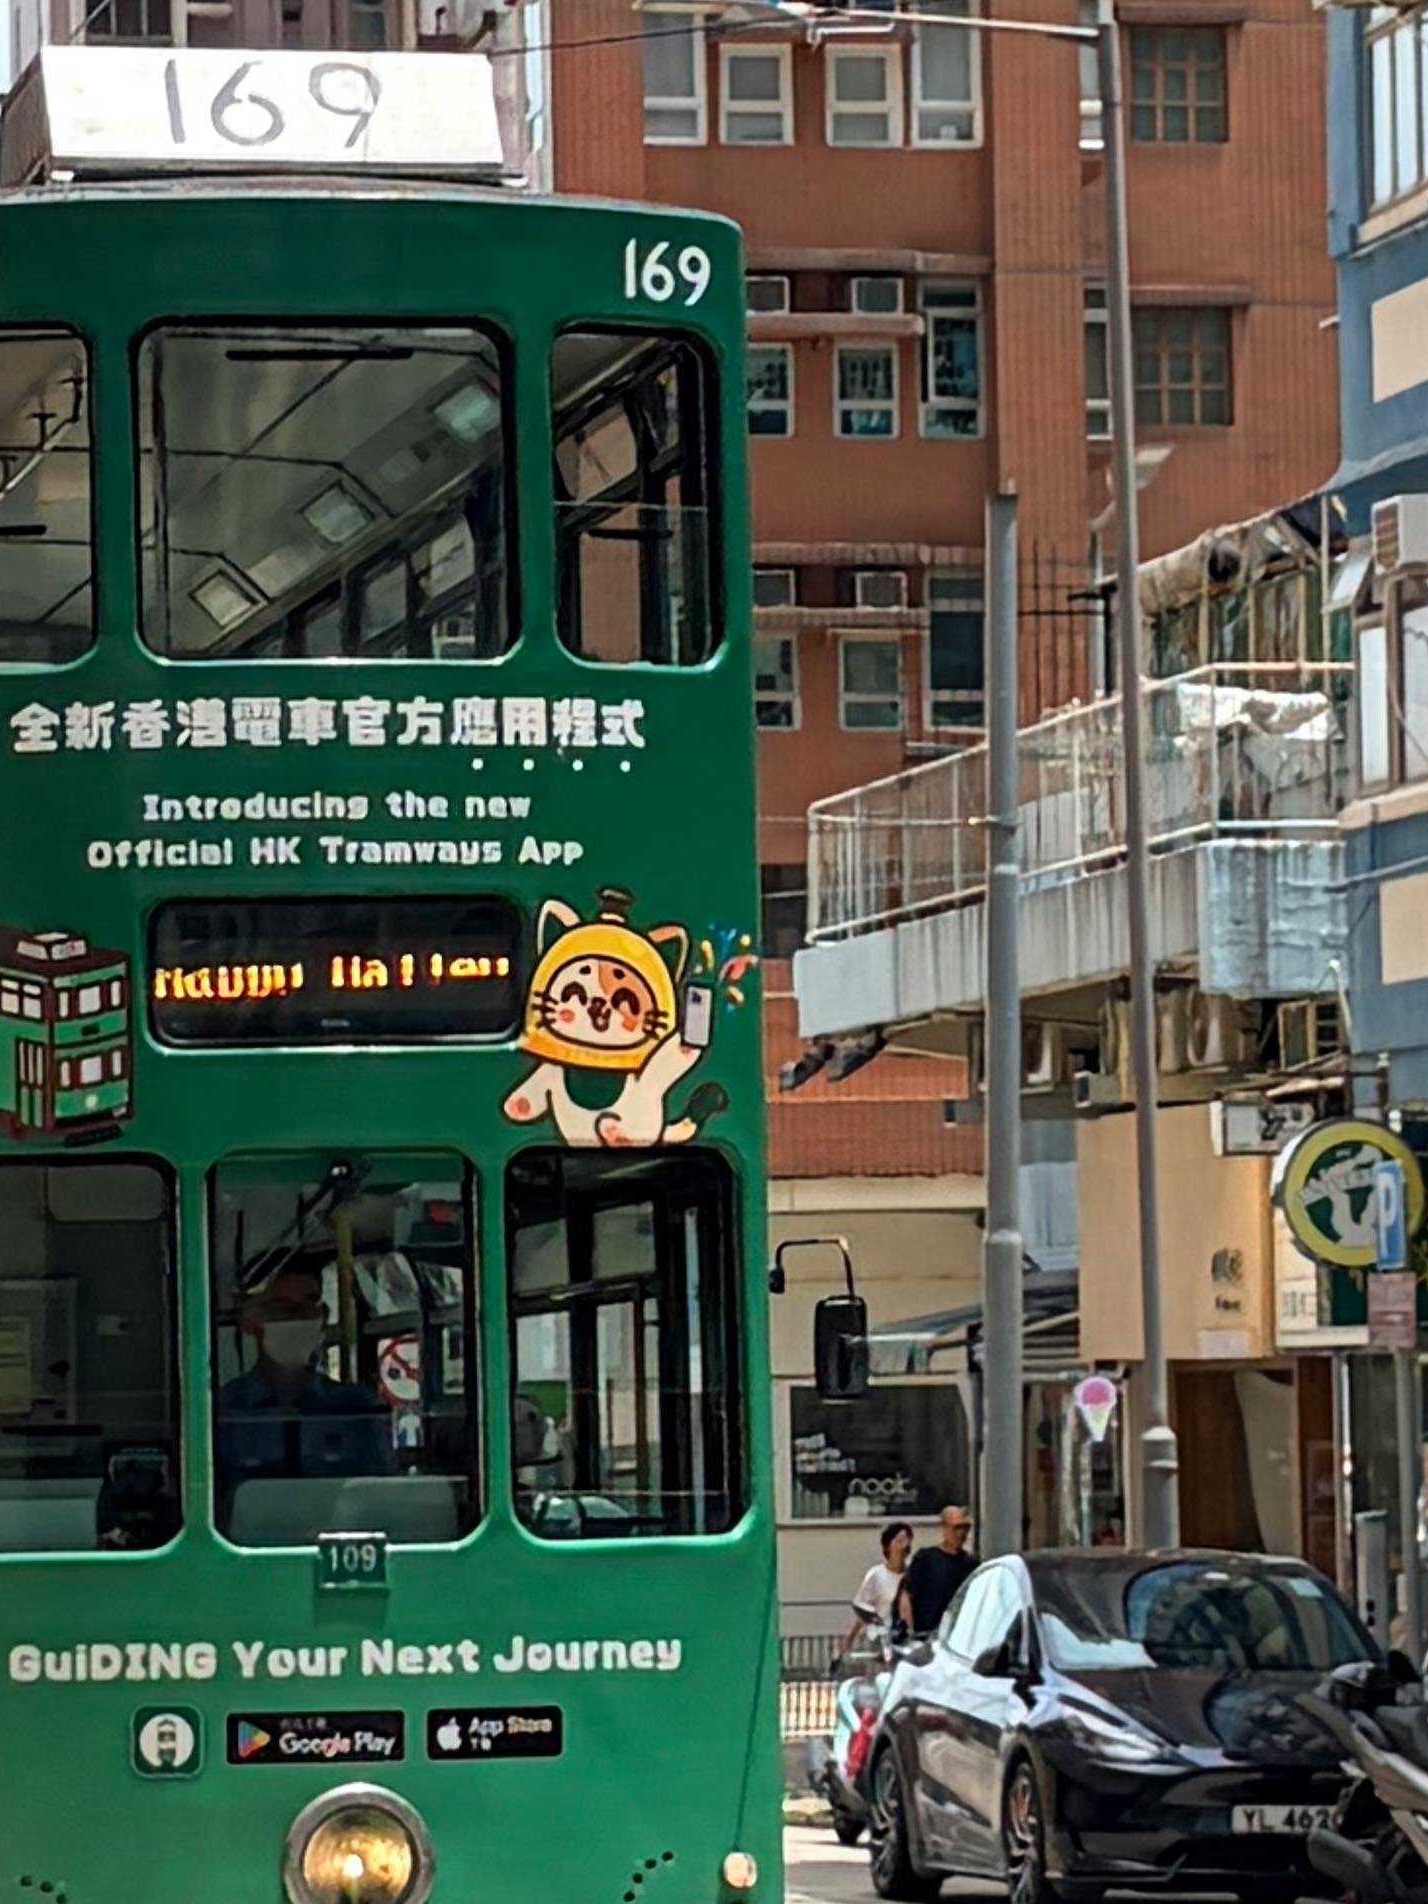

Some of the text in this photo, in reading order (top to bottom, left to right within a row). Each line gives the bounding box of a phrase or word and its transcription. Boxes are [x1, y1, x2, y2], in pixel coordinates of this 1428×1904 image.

[164, 58, 382, 149] 169
[624, 236, 712, 307] 169
[9, 696, 646, 752] 全新香港電車官方應用程式
[142, 791, 532, 822] Introducing the new
[86, 835, 584, 868] Official HK Tramways App
[328, 1543, 377, 1573] 109
[232, 1640, 347, 1680] Your
[360, 1637, 480, 1677] Next
[493, 1634, 683, 1675] Journey
[278, 1730, 396, 1758] Google Play
[1243, 1808, 1275, 1831] YL
